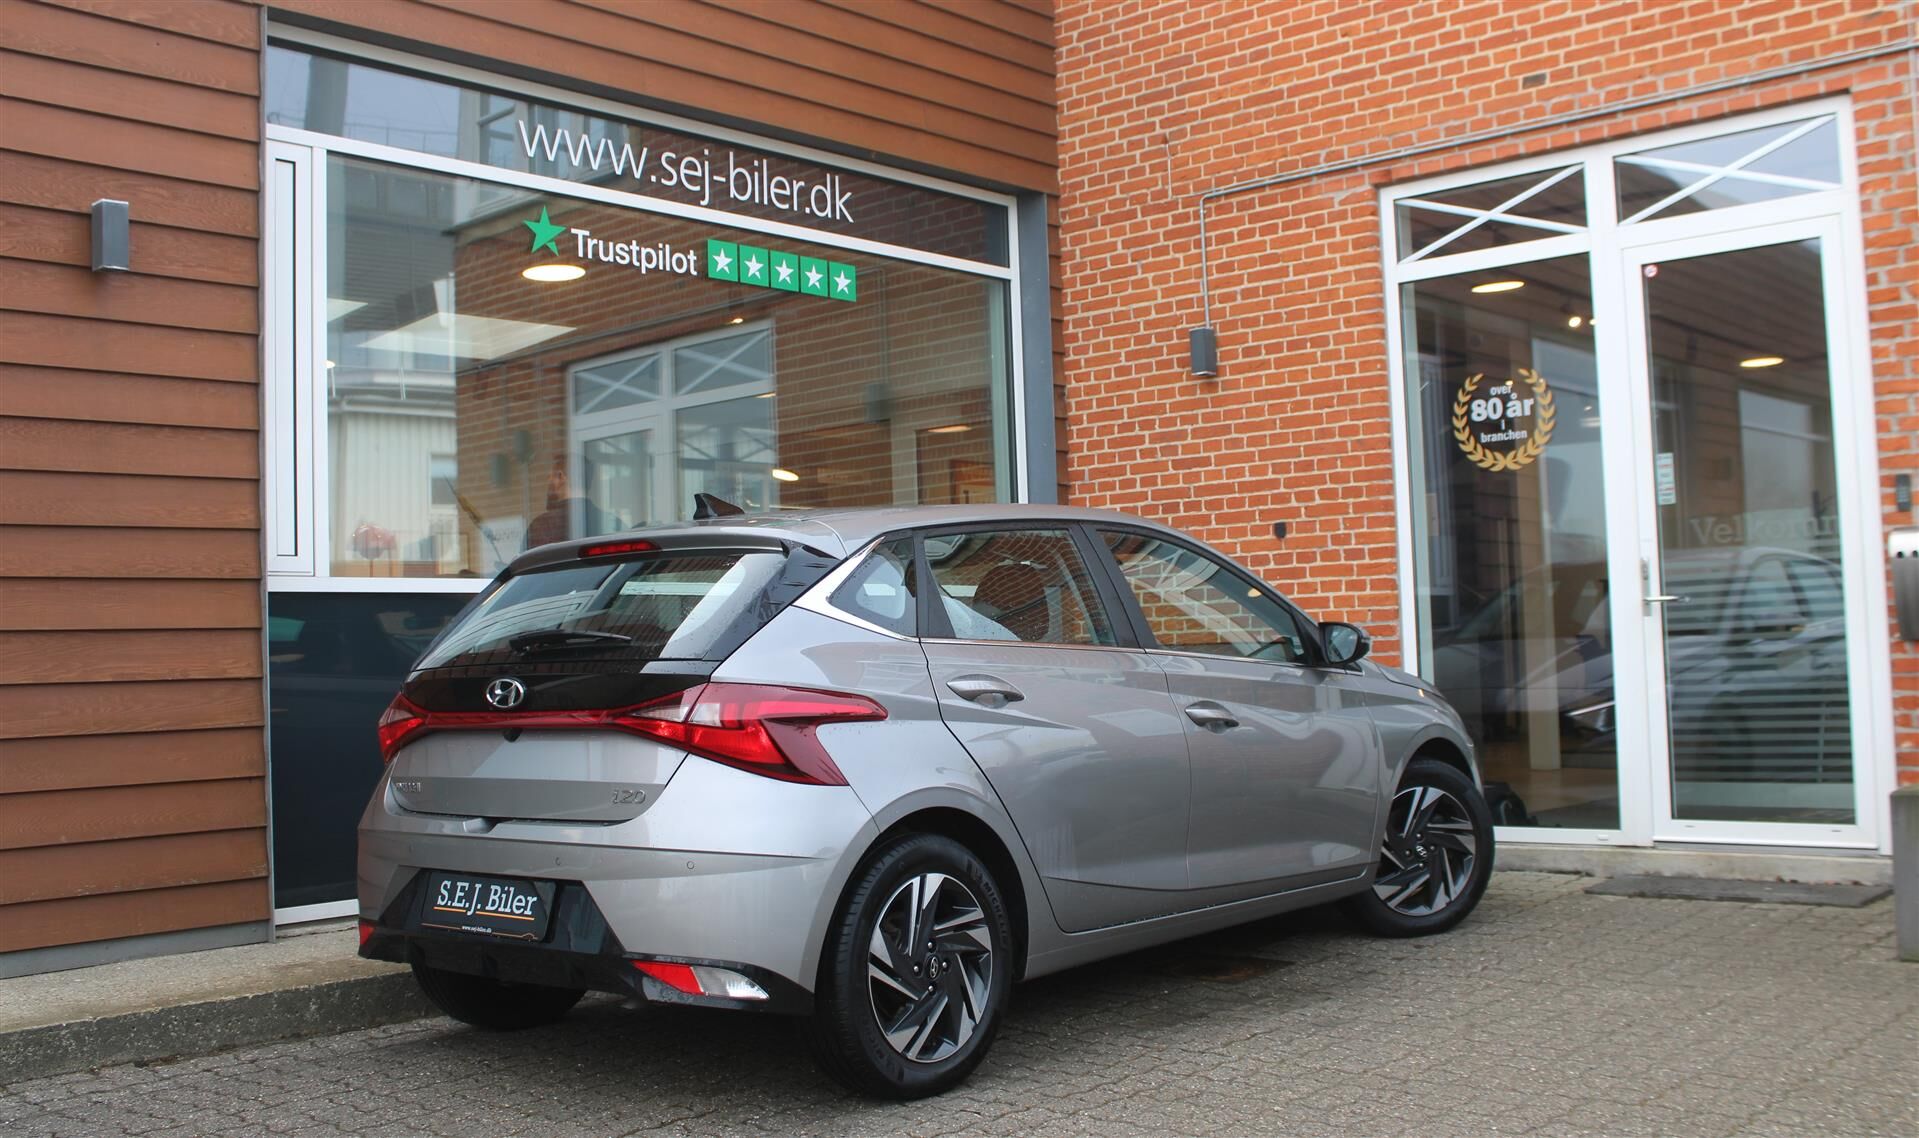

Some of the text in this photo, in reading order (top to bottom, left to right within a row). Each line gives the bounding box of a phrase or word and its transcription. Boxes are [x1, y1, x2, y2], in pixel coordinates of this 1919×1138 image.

[518, 119, 855, 223] www.sej-biler.dk
[570, 228, 698, 276] Trustpilot
[1490, 384, 1512, 396] over
[1471, 392, 1534, 422] 80 år
[1480, 429, 1528, 443] branchen
[1501, 419, 1506, 430] i
[437, 880, 538, 916] S.E.J. Biler
